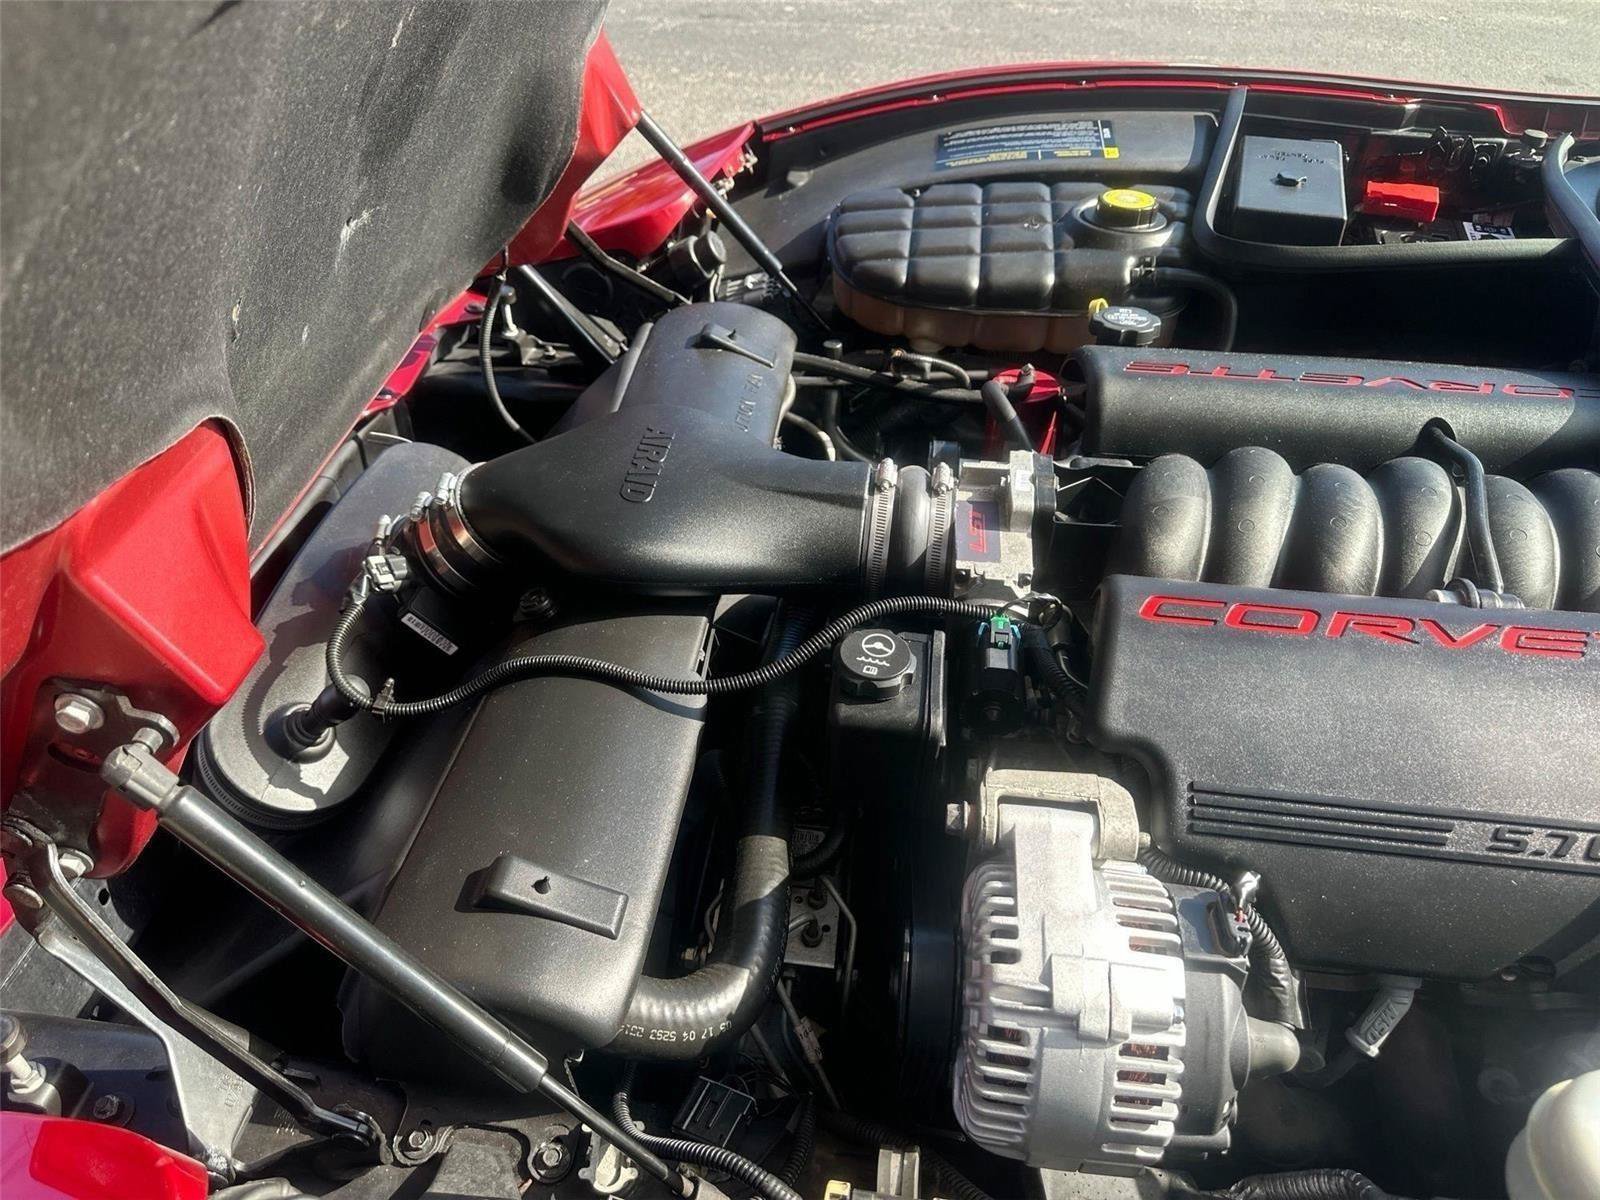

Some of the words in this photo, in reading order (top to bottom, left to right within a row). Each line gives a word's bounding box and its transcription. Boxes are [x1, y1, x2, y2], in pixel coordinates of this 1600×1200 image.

[1123, 361, 1600, 399] ORVETTE
[619, 425, 676, 503] AIRAID
[1138, 594, 1600, 660] CORVE
